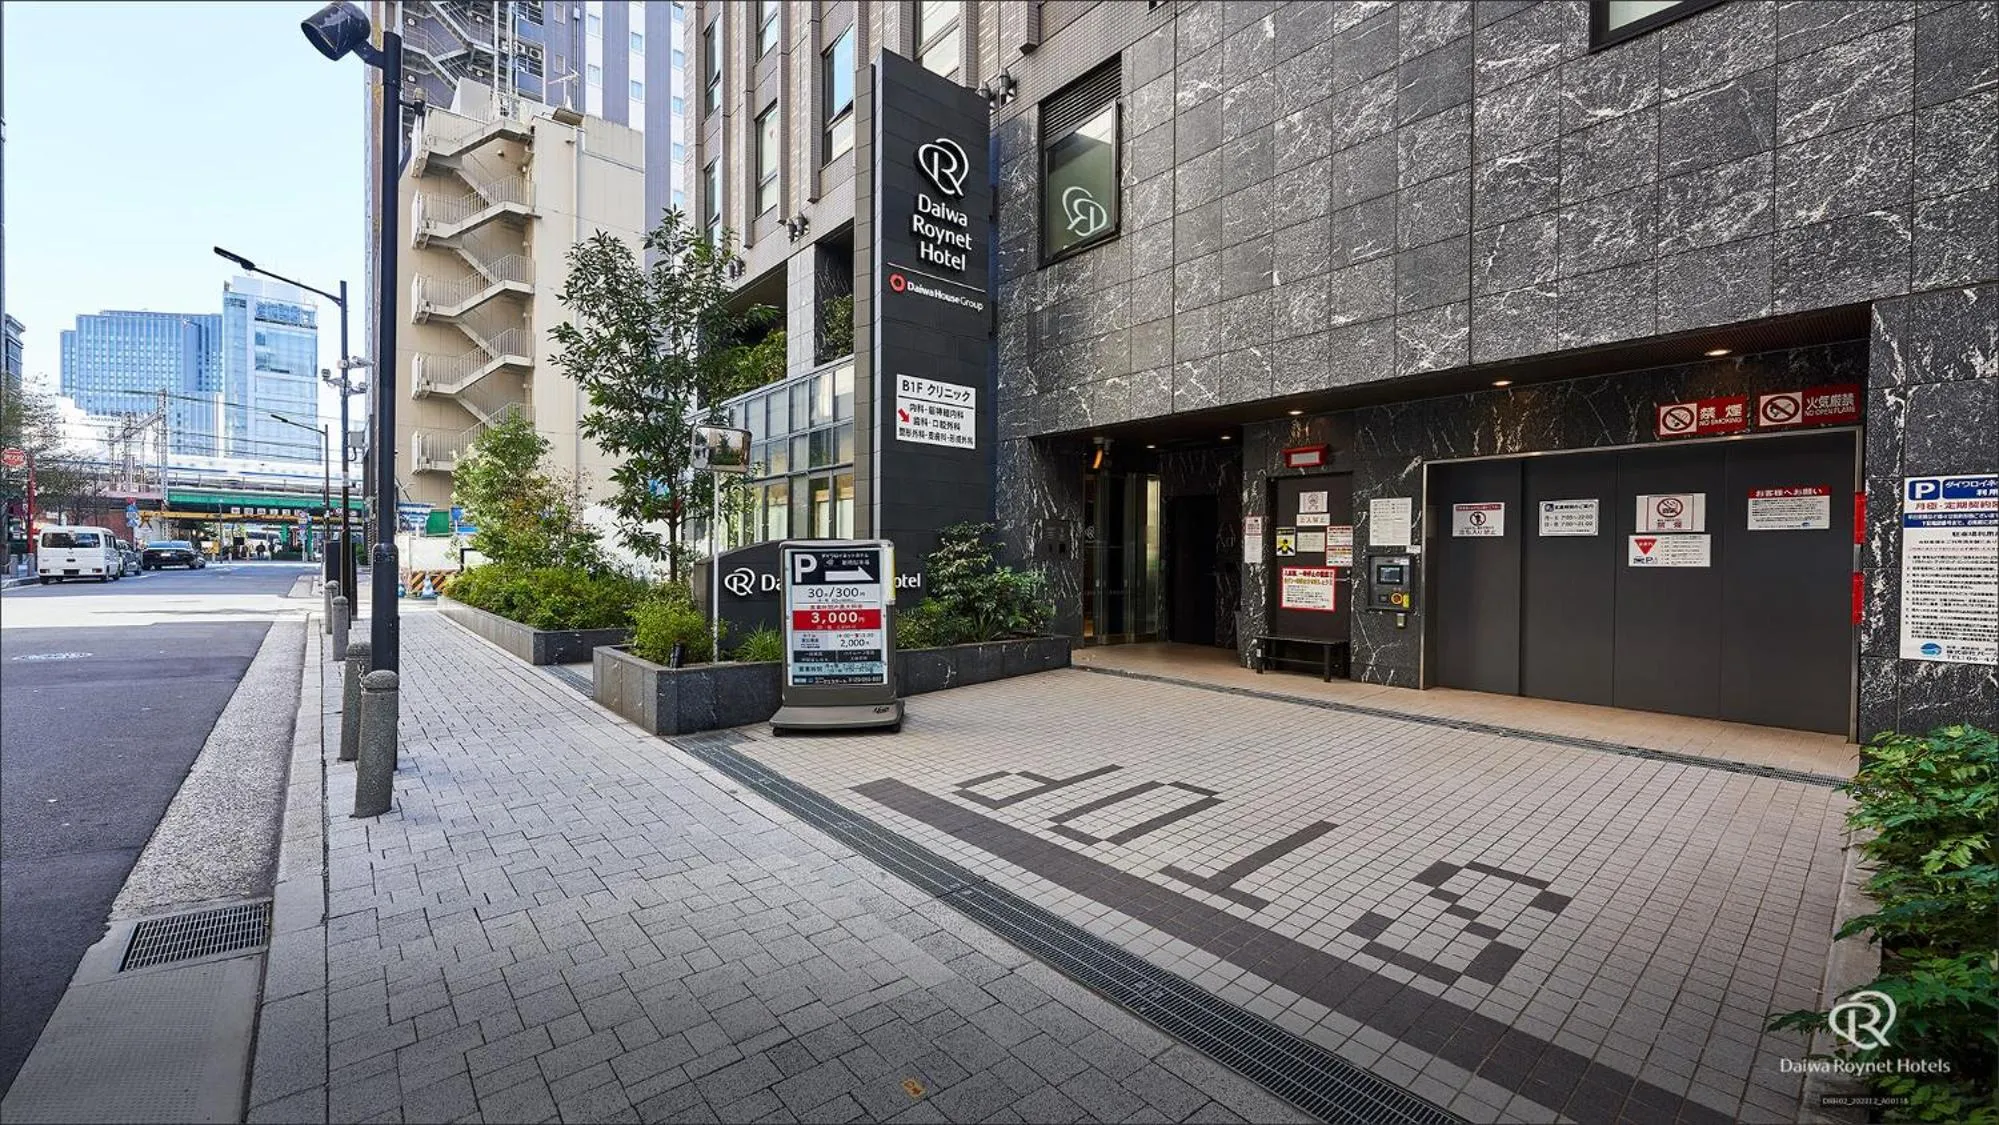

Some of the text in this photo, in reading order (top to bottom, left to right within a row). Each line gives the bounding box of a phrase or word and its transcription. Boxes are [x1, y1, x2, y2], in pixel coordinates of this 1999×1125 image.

[919, 193, 968, 227] Daiwa
[912, 214, 972, 250] Roynet
[920, 241, 966, 271] Hotel
[903, 380, 971, 402] B1F クリニック
[1803, 406, 1856, 417] NO OPEN FLAME
[1806, 393, 1856, 410] 火気厳禁
[1699, 417, 1742, 427] NO SMOKING
[1915, 483, 1936, 499] P
[794, 554, 818, 583] P
[761, 574, 781, 592] Da
[892, 574, 922, 589] otel
